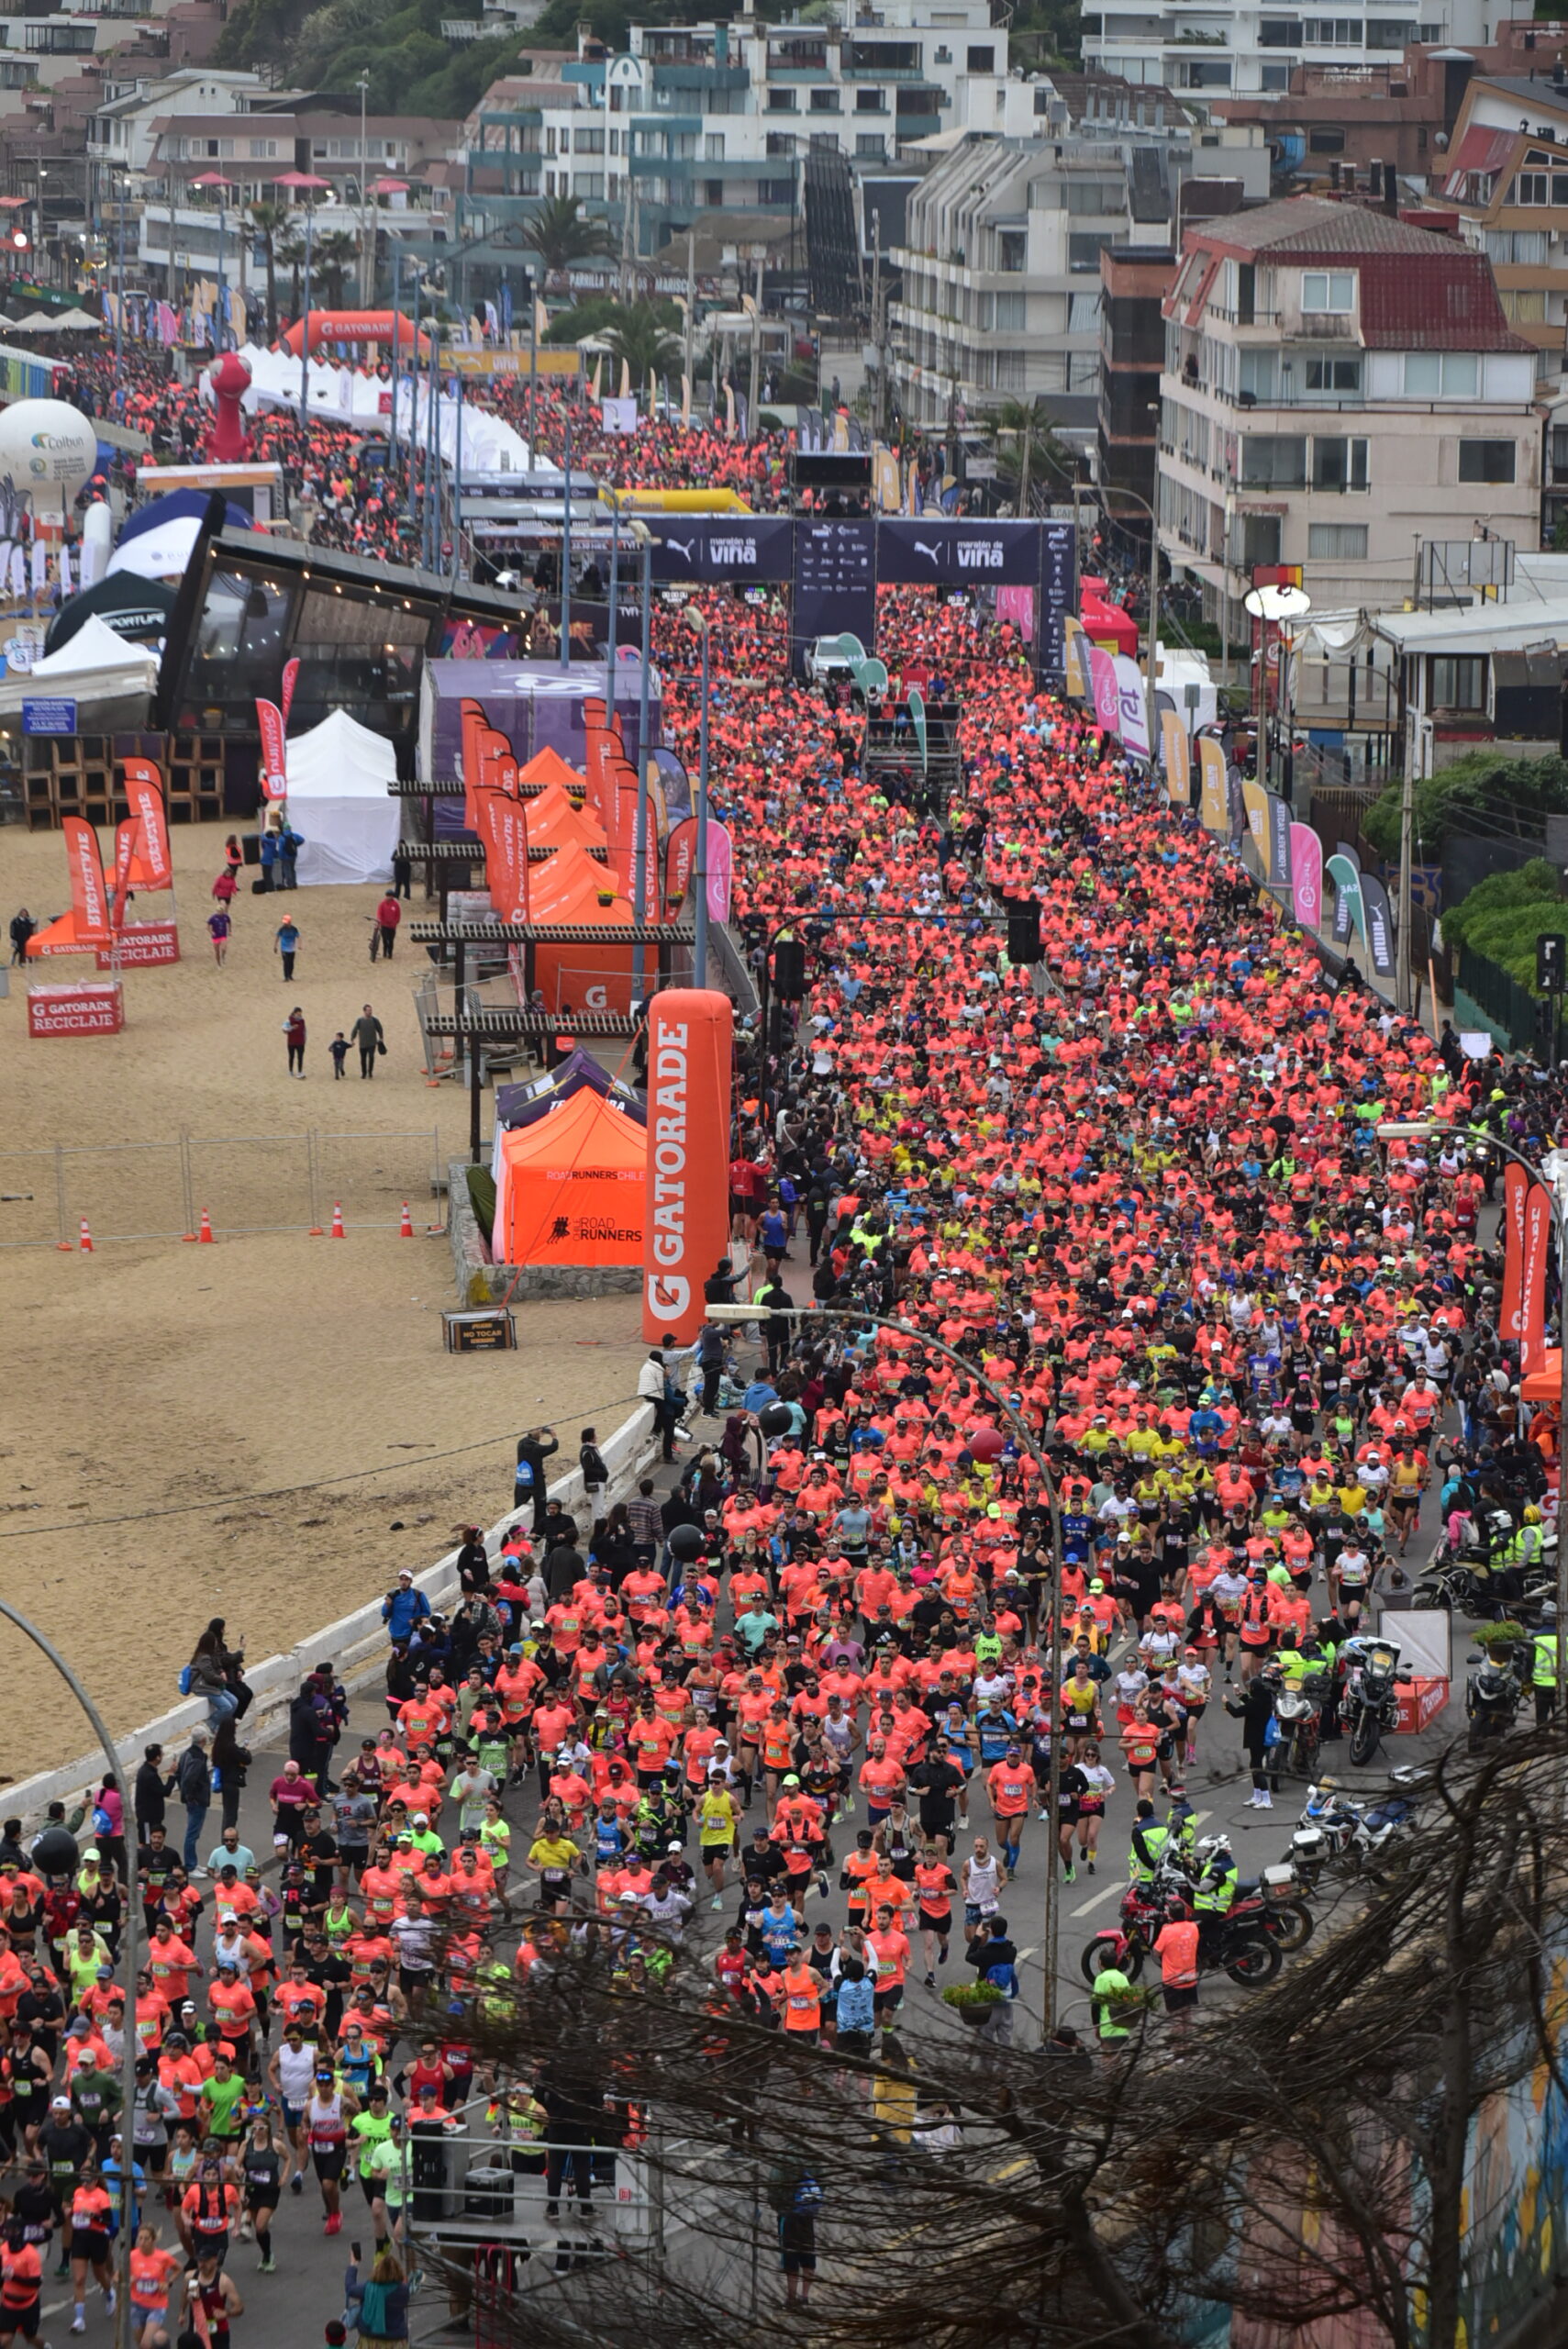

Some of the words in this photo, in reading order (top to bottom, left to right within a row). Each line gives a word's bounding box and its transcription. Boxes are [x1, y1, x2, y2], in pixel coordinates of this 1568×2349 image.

[569, 272, 605, 289] PARRILLA
[655, 277, 698, 294] MARISCS
[335, 322, 392, 334] GATORADE
[746, 536, 756, 546] de
[993, 540, 1004, 550] de
[585, 985, 606, 1008] G
[33, 1013, 115, 1030] RECICLAJE
[652, 1022, 689, 1266] GATORADE
[580, 1217, 616, 1230] ROAD
[580, 1229, 643, 1242] RUNNERS
[647, 1274, 691, 1321] G
